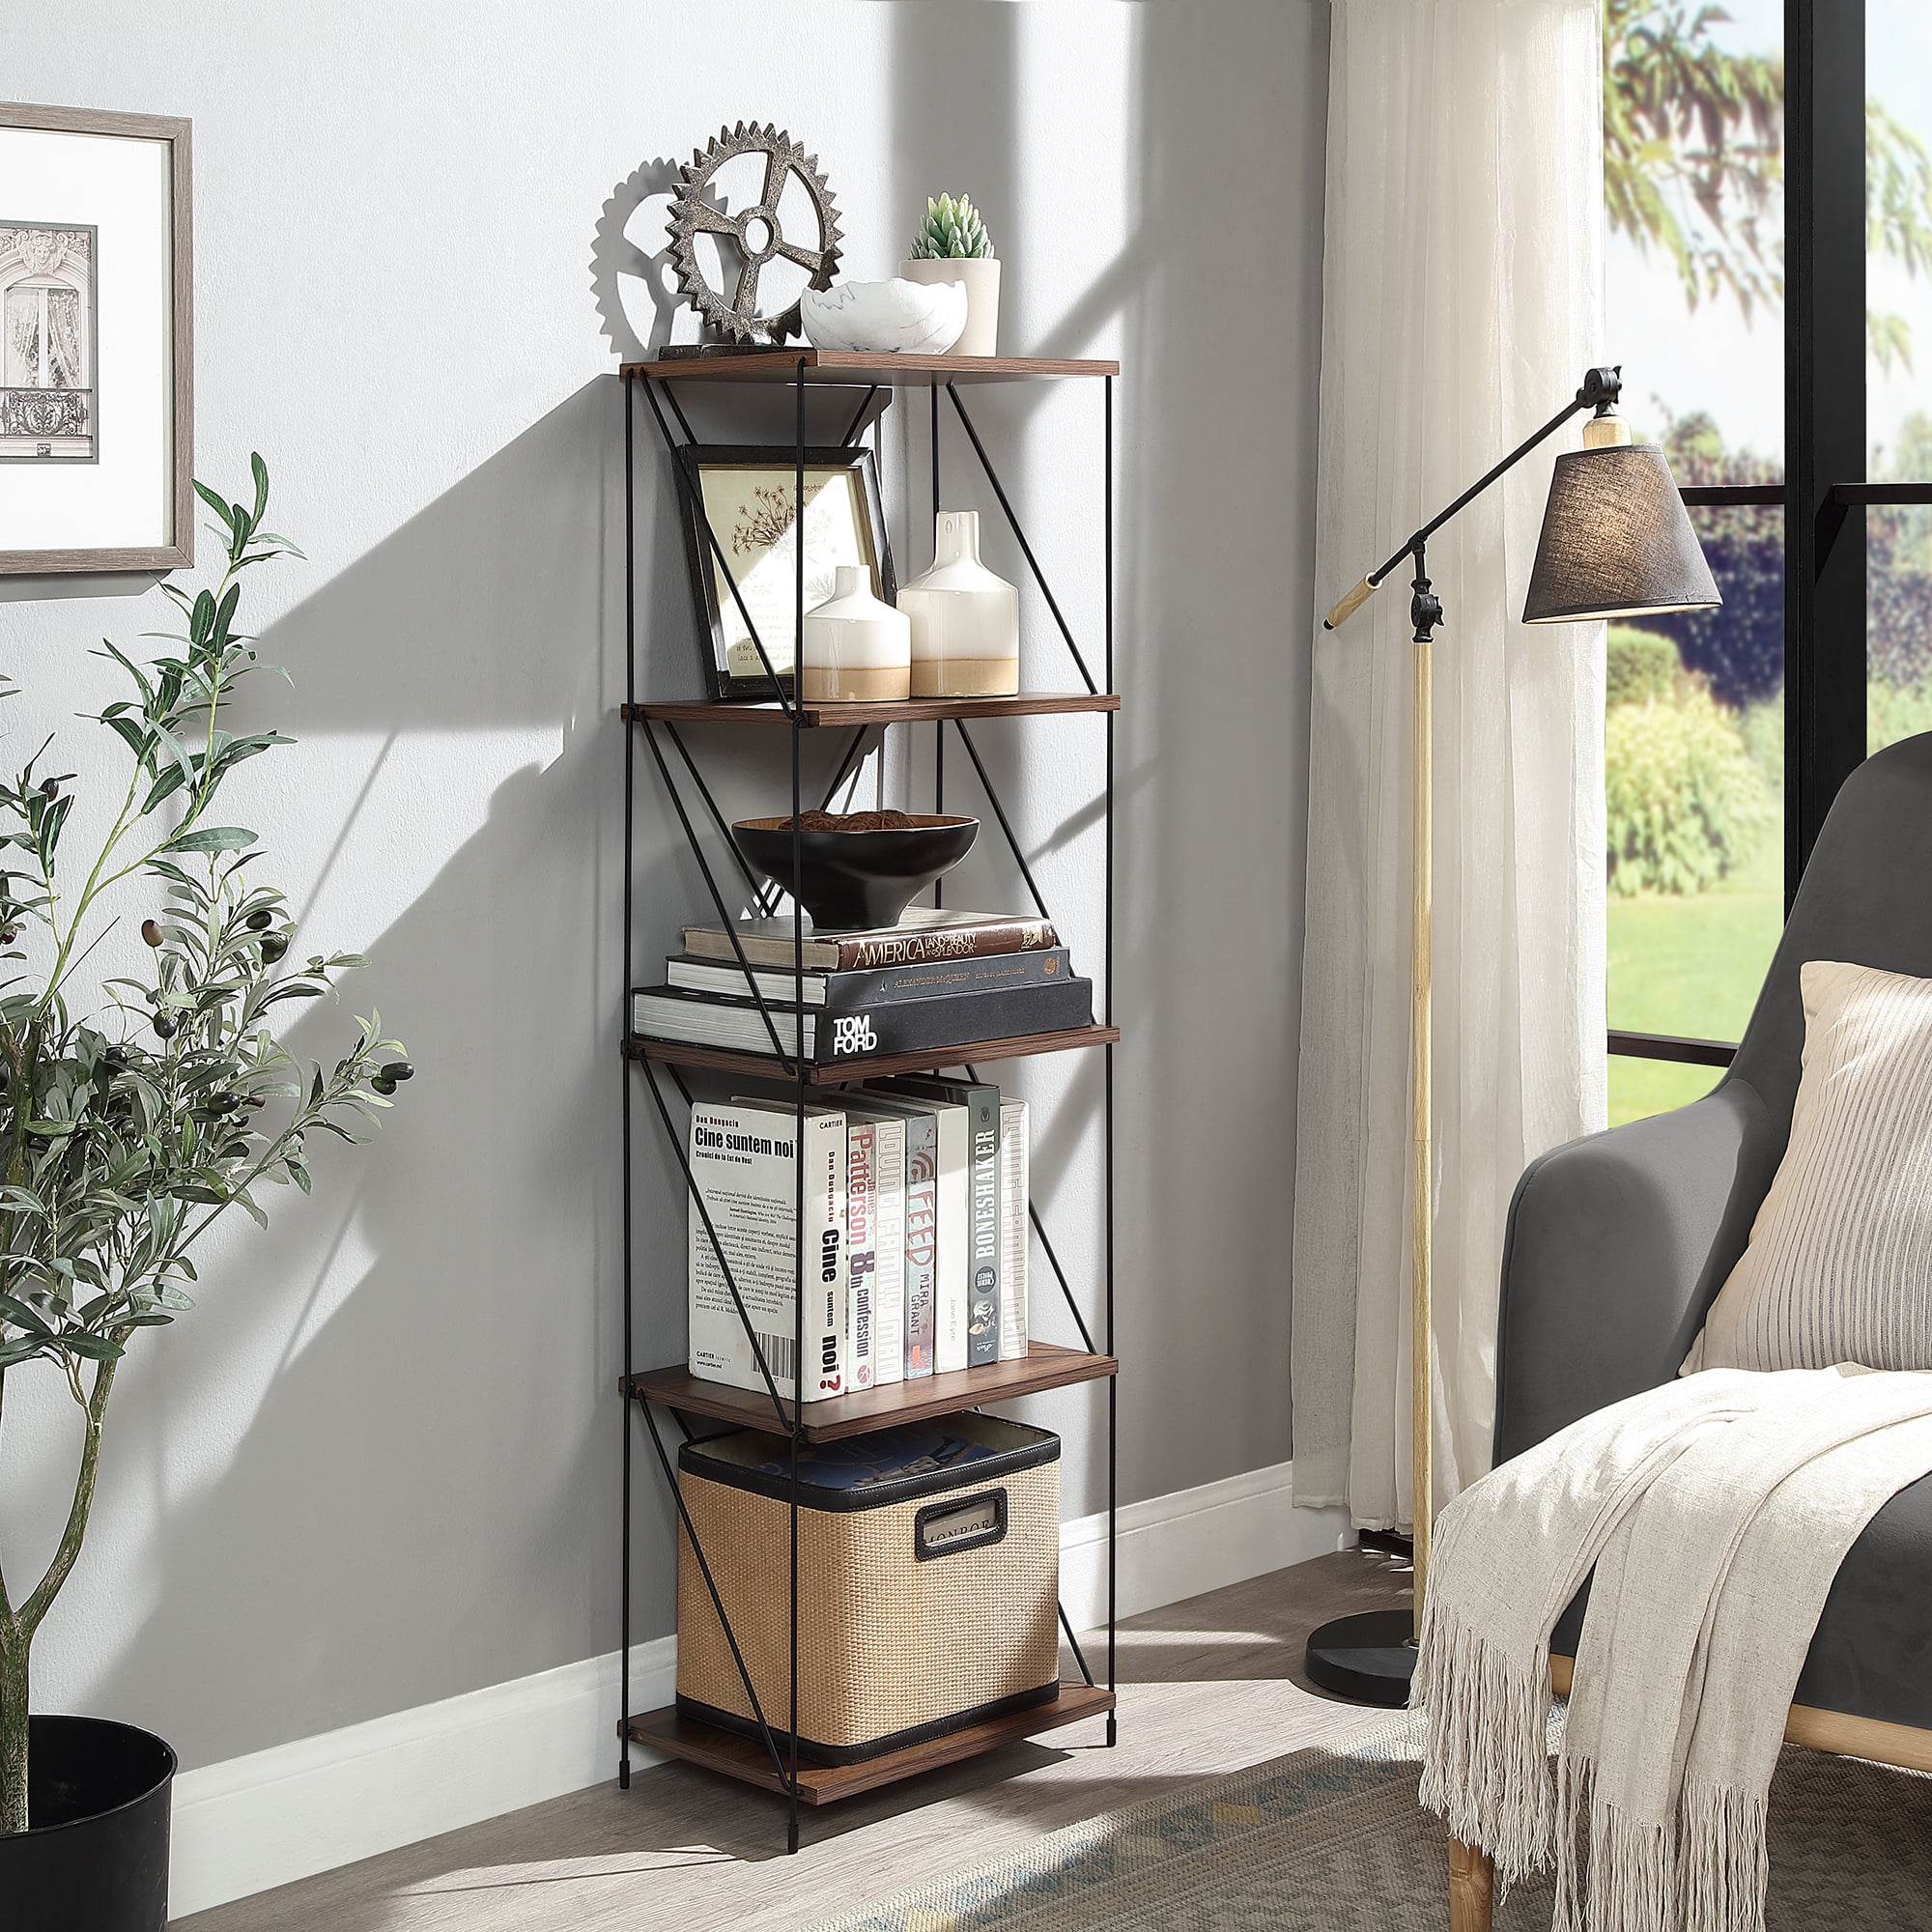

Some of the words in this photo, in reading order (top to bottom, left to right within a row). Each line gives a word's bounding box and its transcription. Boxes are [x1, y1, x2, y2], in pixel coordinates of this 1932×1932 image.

[853, 938, 925, 968] AMERICA
[925, 937, 945, 949] LAND
[951, 933, 976, 946] BEAUTY
[934, 943, 975, 957] SPLENDOR
[834, 1014, 869, 1037] TOM
[834, 1032, 877, 1055] FORD
[696, 1115, 707, 1123] Dan
[819, 1120, 843, 1129] CARTIER
[696, 1126, 724, 1149] Cine
[726, 1133, 772, 1155] suntem
[775, 1139, 797, 1158] noi
[850, 1134, 873, 1245] Patterson
[975, 1129, 995, 1260] BONESHAKER
[906, 1190, 934, 1266] FEED
[821, 1229, 839, 1283] Cine
[850, 1251, 874, 1289] 8th
[919, 1273, 929, 1307] MIRA
[857, 1288, 871, 1357] confession
[910, 1294, 920, 1335] GRANT
[696, 1350, 714, 1359] CARTIER
